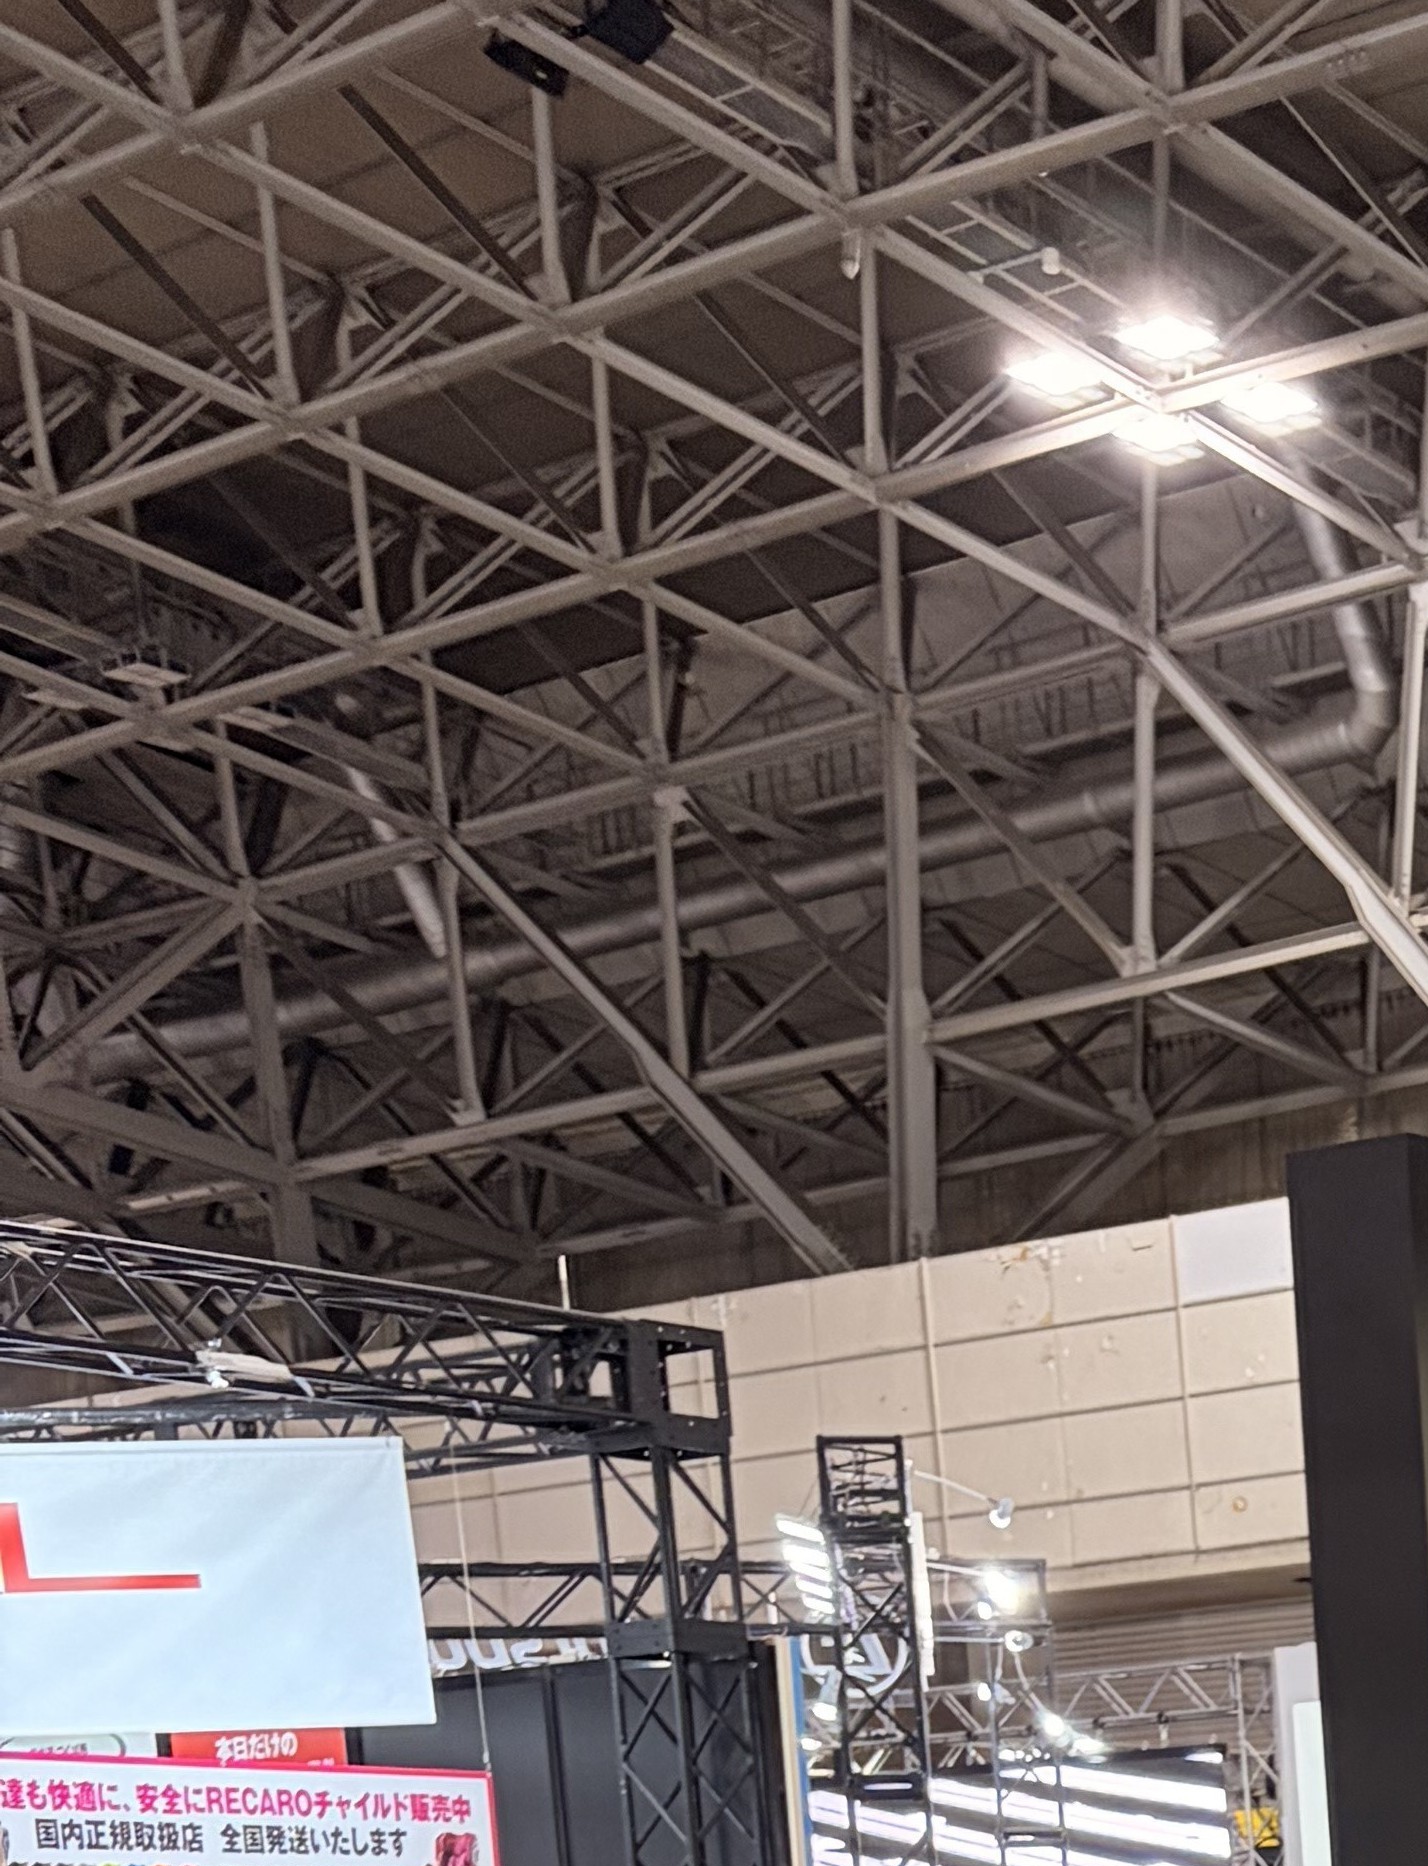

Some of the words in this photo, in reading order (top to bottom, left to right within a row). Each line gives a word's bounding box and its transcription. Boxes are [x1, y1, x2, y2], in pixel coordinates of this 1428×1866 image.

[35, 1818, 203, 1852] 国内正規取扱店
[220, 1823, 407, 1857] 全国発送いたします
